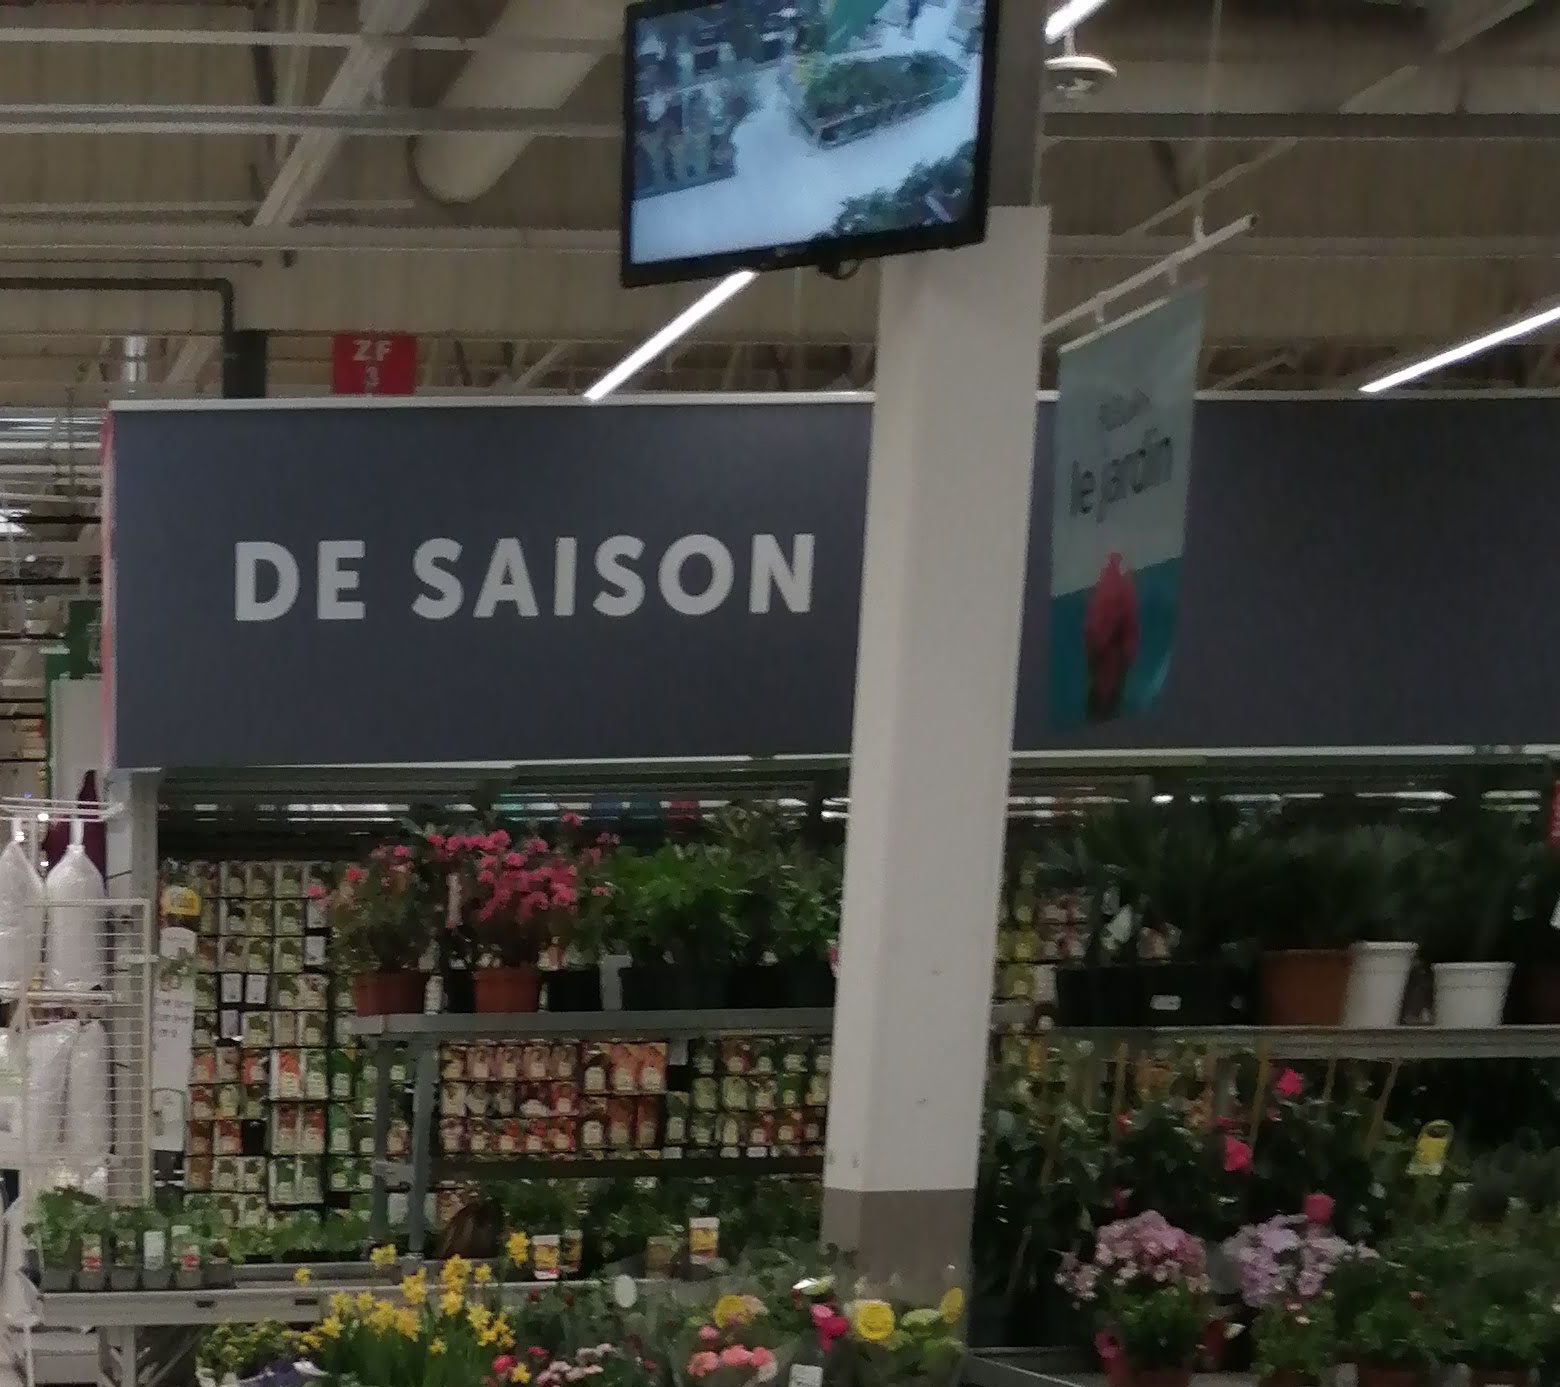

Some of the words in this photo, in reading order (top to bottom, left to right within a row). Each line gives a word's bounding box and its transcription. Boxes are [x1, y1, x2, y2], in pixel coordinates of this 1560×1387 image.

[352, 340, 393, 361] ZF
[235, 538, 366, 622] DE
[412, 533, 815, 619] SAISON
